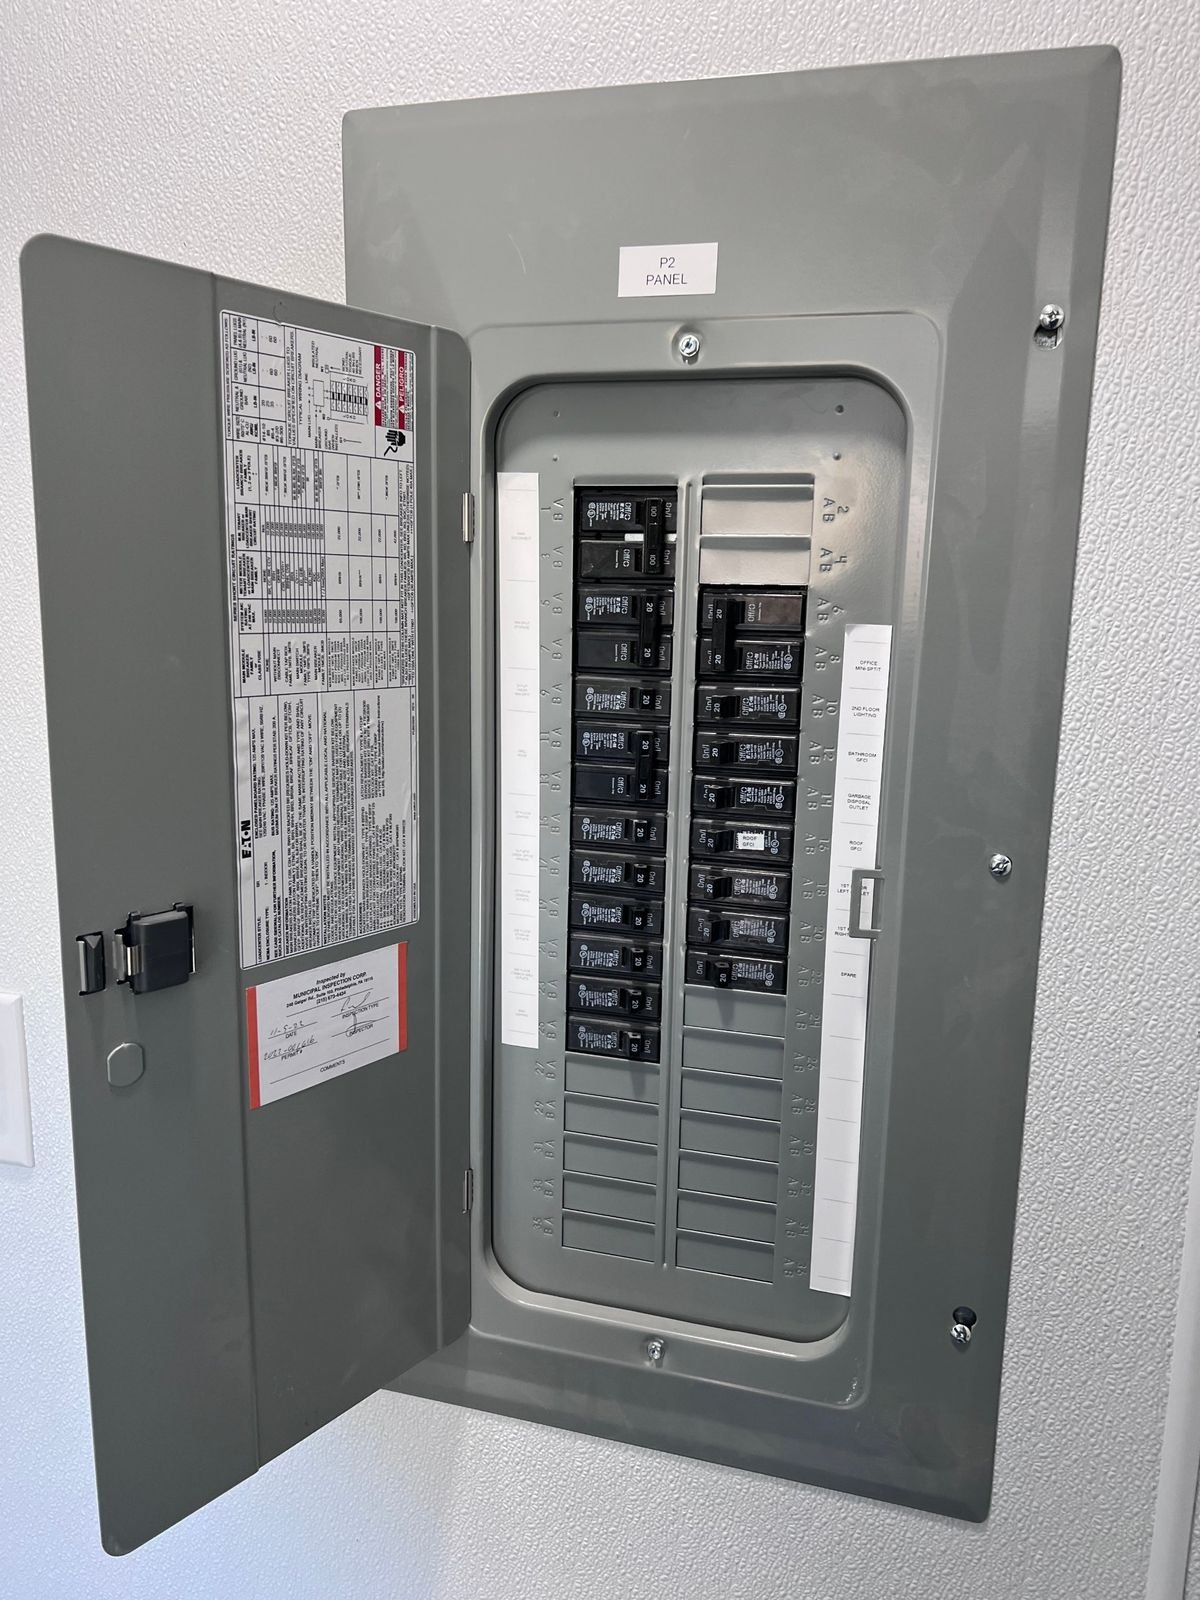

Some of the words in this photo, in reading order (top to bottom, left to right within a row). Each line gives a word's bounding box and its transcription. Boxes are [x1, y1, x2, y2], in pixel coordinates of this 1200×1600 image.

[660, 257, 676, 269] P2
[646, 274, 688, 286] PANEL
[824, 497, 836, 508] A
[650, 505, 658, 518] 100
[838, 505, 850, 514] 2
[823, 514, 835, 522] B
[820, 548, 833, 558] A
[649, 553, 657, 566] 100
[834, 555, 848, 564] 4
[646, 602, 654, 613] 20
[818, 598, 831, 608] A
[716, 609, 723, 619] 20
[831, 605, 845, 615] 6
[817, 613, 830, 623] B
[644, 647, 651, 658] 20
[815, 647, 828, 657] A
[715, 654, 722, 664] 20
[829, 654, 841, 663] 8
[815, 662, 826, 671] B
[643, 695, 650, 705] 20
[812, 693, 824, 705] A
[713, 703, 721, 713] 20
[826, 700, 838, 716] 10
[812, 708, 823, 719] B
[539, 731, 550, 742] 11
[642, 740, 649, 750] 20
[809, 740, 821, 751] A
[711, 747, 719, 757] 20
[823, 746, 836, 762] 12
[809, 755, 820, 765] B
[539, 773, 550, 785] 13
[640, 784, 647, 794] 20
[708, 793, 716, 802] 20
[820, 793, 833, 808] 14
[539, 815, 549, 828] 15
[637, 828, 644, 838] 20
[240, 819, 252, 859] EATON
[707, 838, 714, 848] 20
[818, 838, 830, 852] 16
[637, 873, 644, 883] 20
[707, 884, 713, 893] 20
[816, 883, 828, 897] 18
[635, 916, 642, 926] 20
[703, 927, 711, 937] 20
[813, 925, 825, 942] 20
[635, 957, 642, 967] 20
[315, 973, 340, 985] Inspected
[719, 973, 727, 983] 20
[840, 971, 857, 980] SPARE
[293, 986, 321, 999] MUNICIPAL
[321, 977, 352, 990] INSPECTION
[294, 998, 308, 1006] Geiger
[632, 1000, 639, 1010] 20
[342, 1007, 368, 1019] INSPECTION
[368, 1003, 379, 1011] TYPE
[285, 1031, 297, 1039] DATE
[349, 1023, 374, 1037] INSPECTOR
[631, 1043, 638, 1053] 20
[281, 1048, 301, 1061] PERMIT
[319, 1059, 346, 1072] COMMENTS
[534, 1100, 545, 1114] 29
[805, 1097, 817, 1113] 28
[802, 1140, 814, 1155] 30
